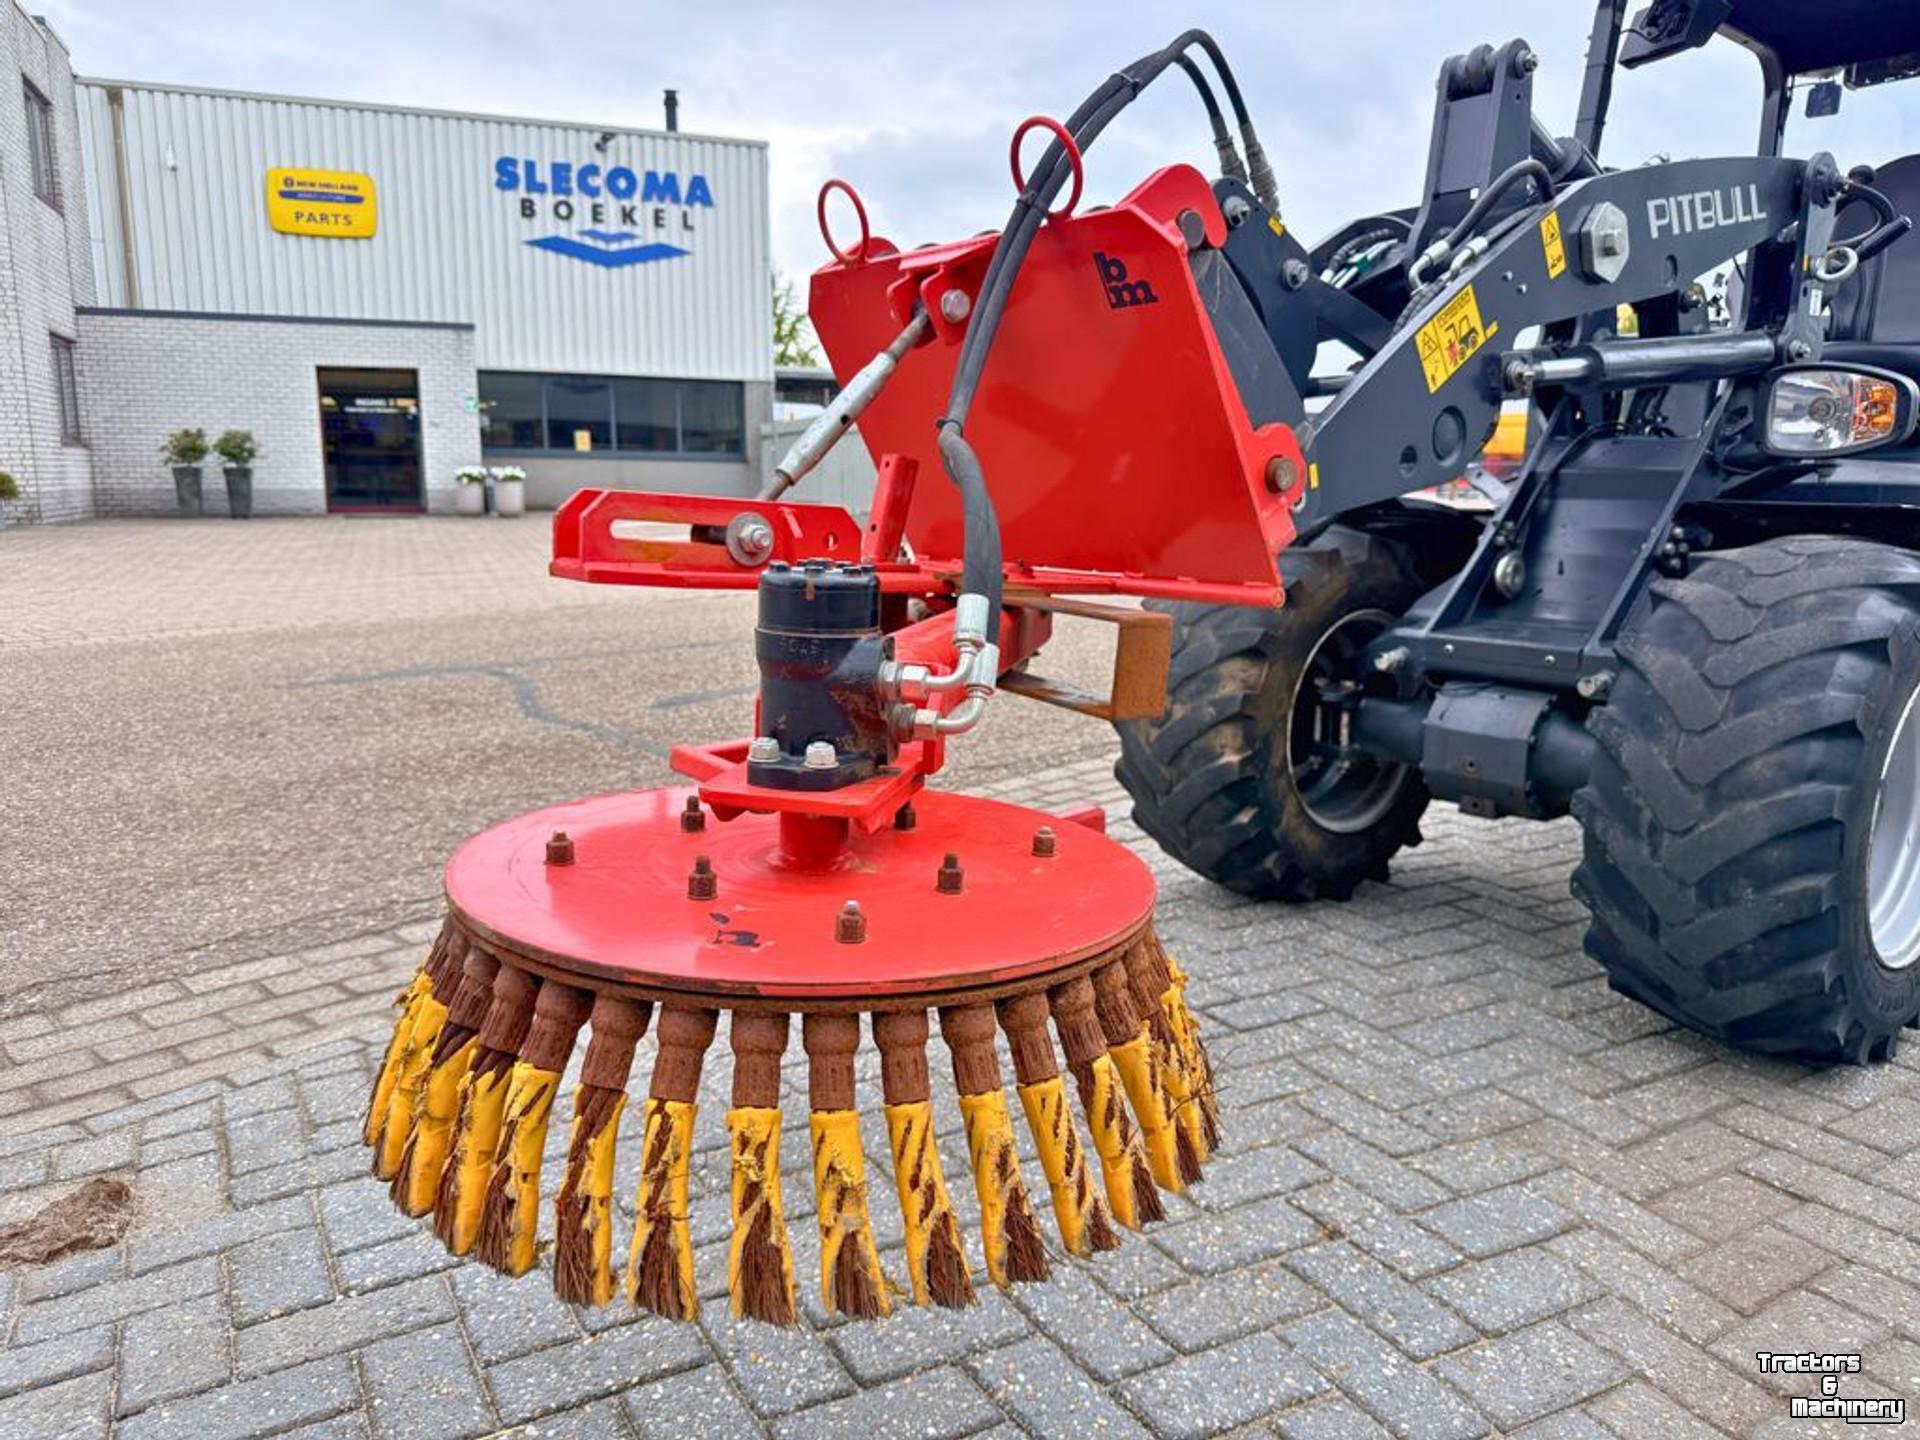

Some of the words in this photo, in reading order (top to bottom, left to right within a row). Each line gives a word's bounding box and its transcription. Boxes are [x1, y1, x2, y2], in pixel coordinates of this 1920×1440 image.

[495, 156, 714, 208] SLECOMA
[294, 210, 353, 226] PARTS
[521, 198, 694, 232] BOEKEL
[1646, 184, 1767, 240] PITBULL
